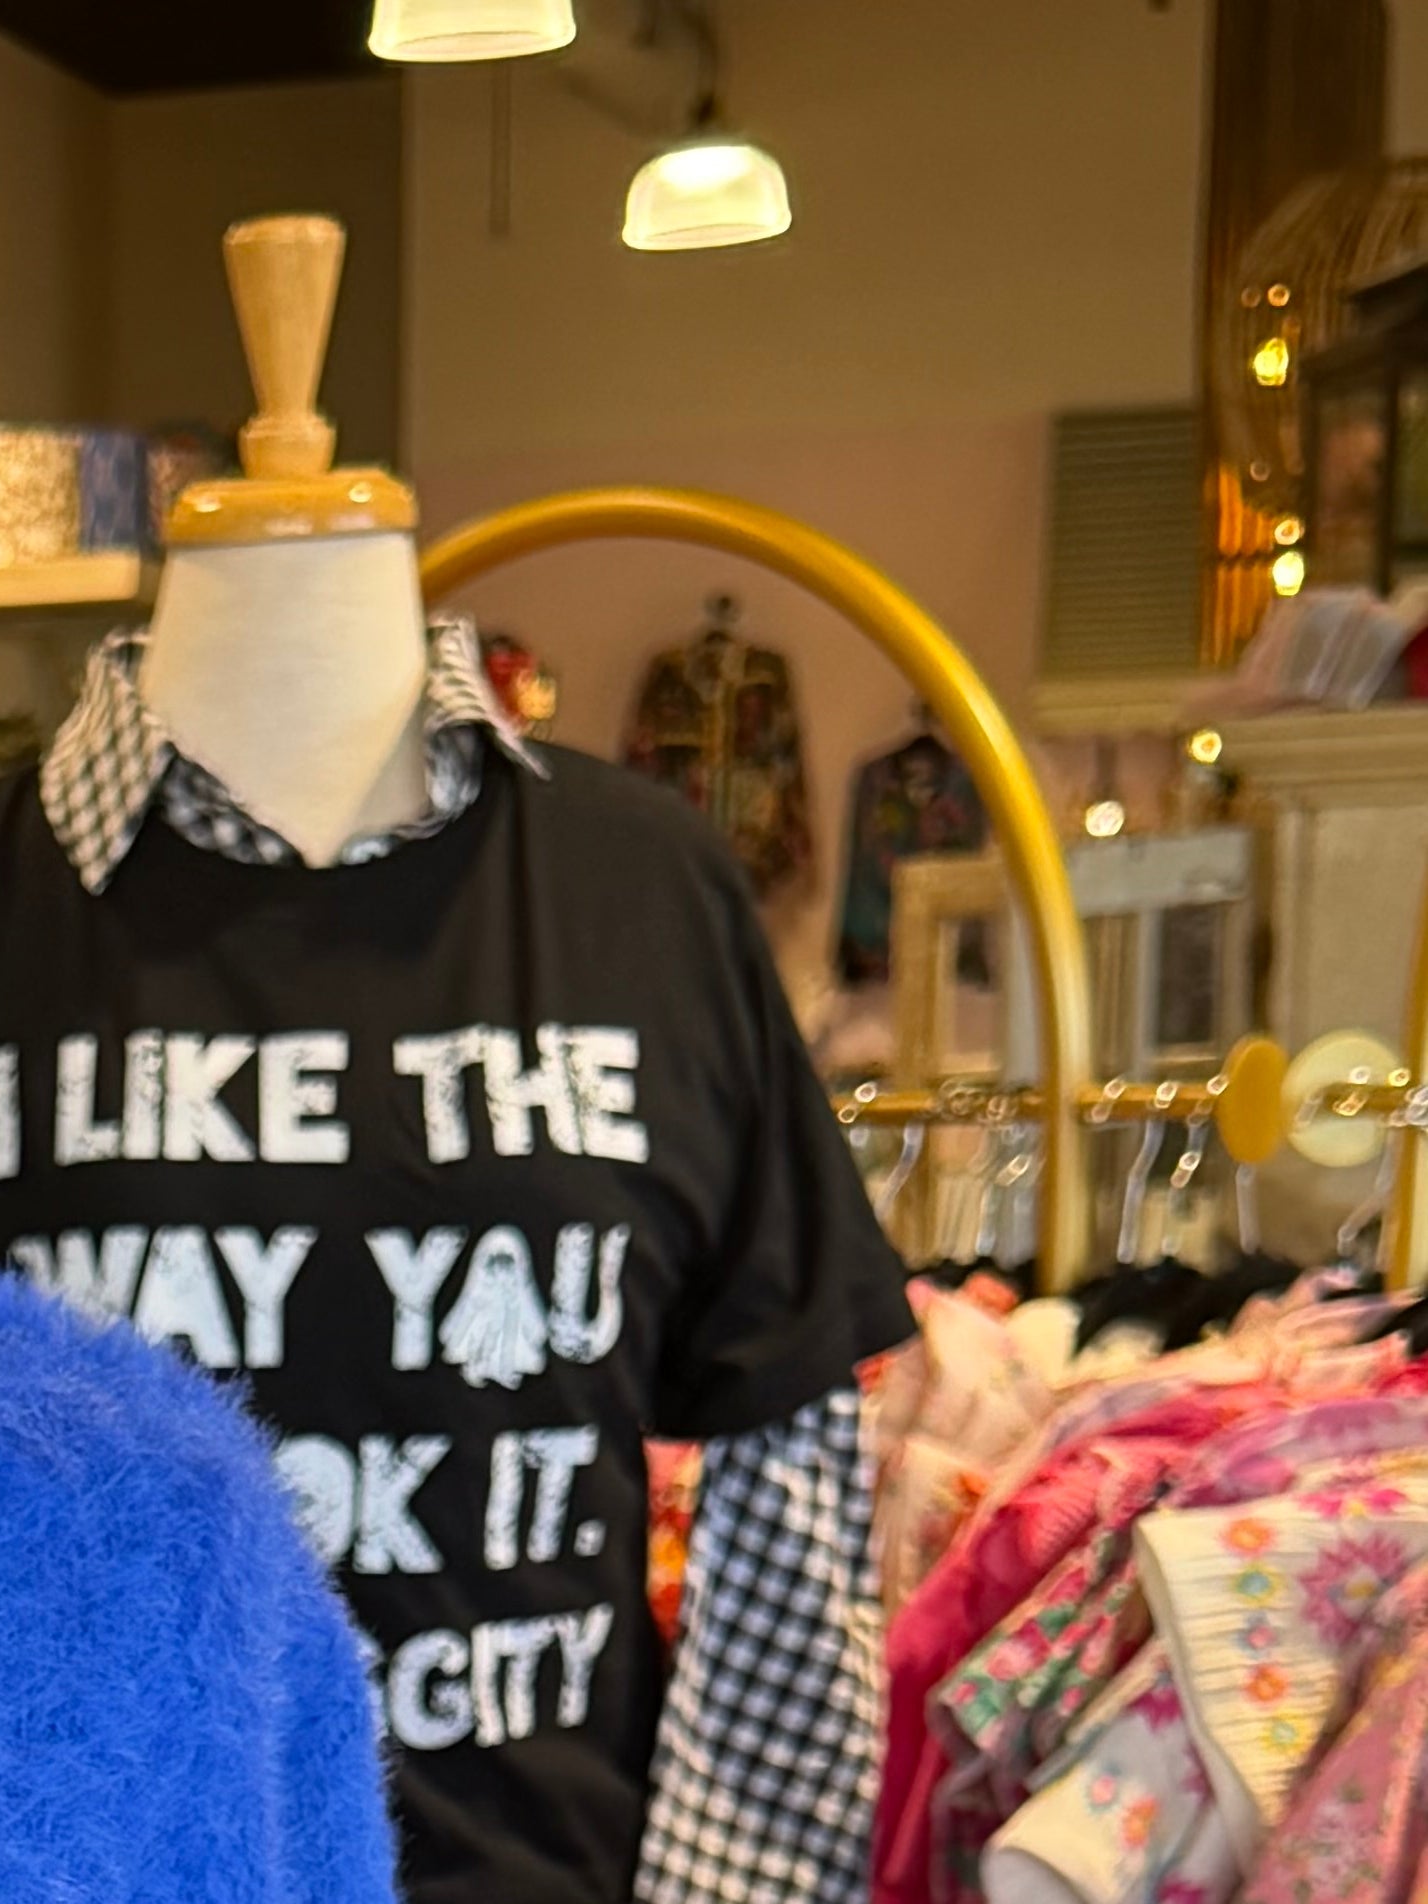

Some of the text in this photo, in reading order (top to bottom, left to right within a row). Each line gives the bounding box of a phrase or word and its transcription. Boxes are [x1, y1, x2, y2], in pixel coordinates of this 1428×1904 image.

[53, 1027, 350, 1166] LIKE
[392, 1022, 649, 1164] THE
[8, 1223, 320, 1370] WAY
[483, 1424, 608, 1572] IT.
